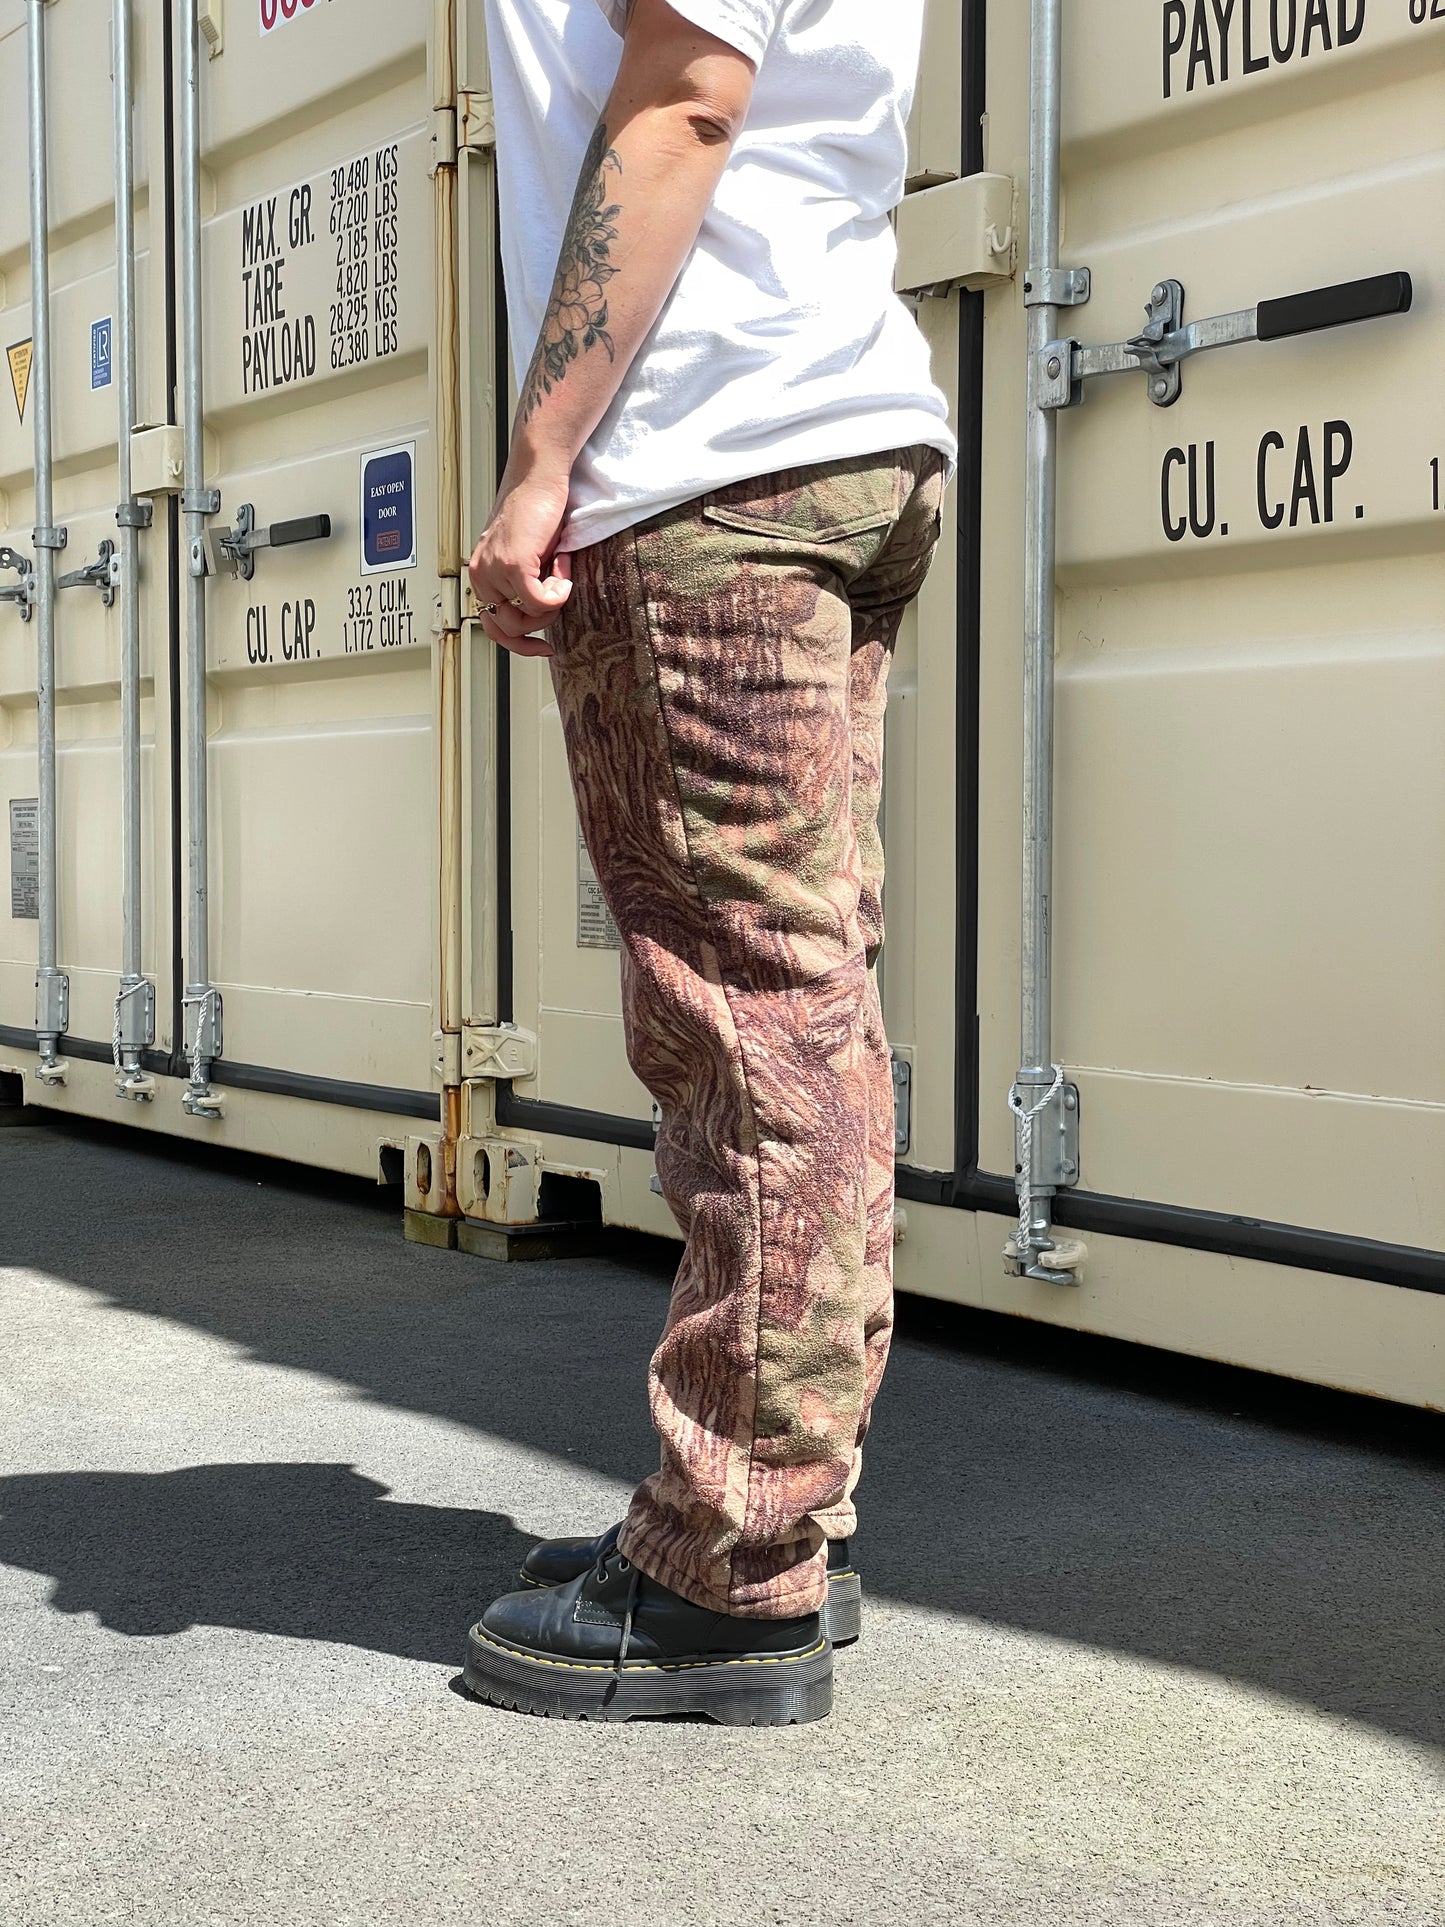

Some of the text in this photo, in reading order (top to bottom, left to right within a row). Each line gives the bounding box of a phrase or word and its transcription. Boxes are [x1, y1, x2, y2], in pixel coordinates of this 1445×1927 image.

[375, 144, 398, 184] KGS
[374, 179, 398, 219] LBS
[242, 183, 315, 268] MAX. GR.
[374, 214, 398, 253] KGS
[374, 250, 398, 288] LBS
[242, 258, 286, 330] TARE
[374, 284, 398, 323] KGS
[242, 314, 316, 394] PAYLOAD
[375, 320, 398, 358] LBS
[370, 480, 405, 498] EASY OPEN
[1161, 419, 1364, 542] CU. CAP.
[378, 506, 397, 520] DOOR
[347, 585, 373, 619] 33.2
[246, 598, 321, 665] CU. CAP.
